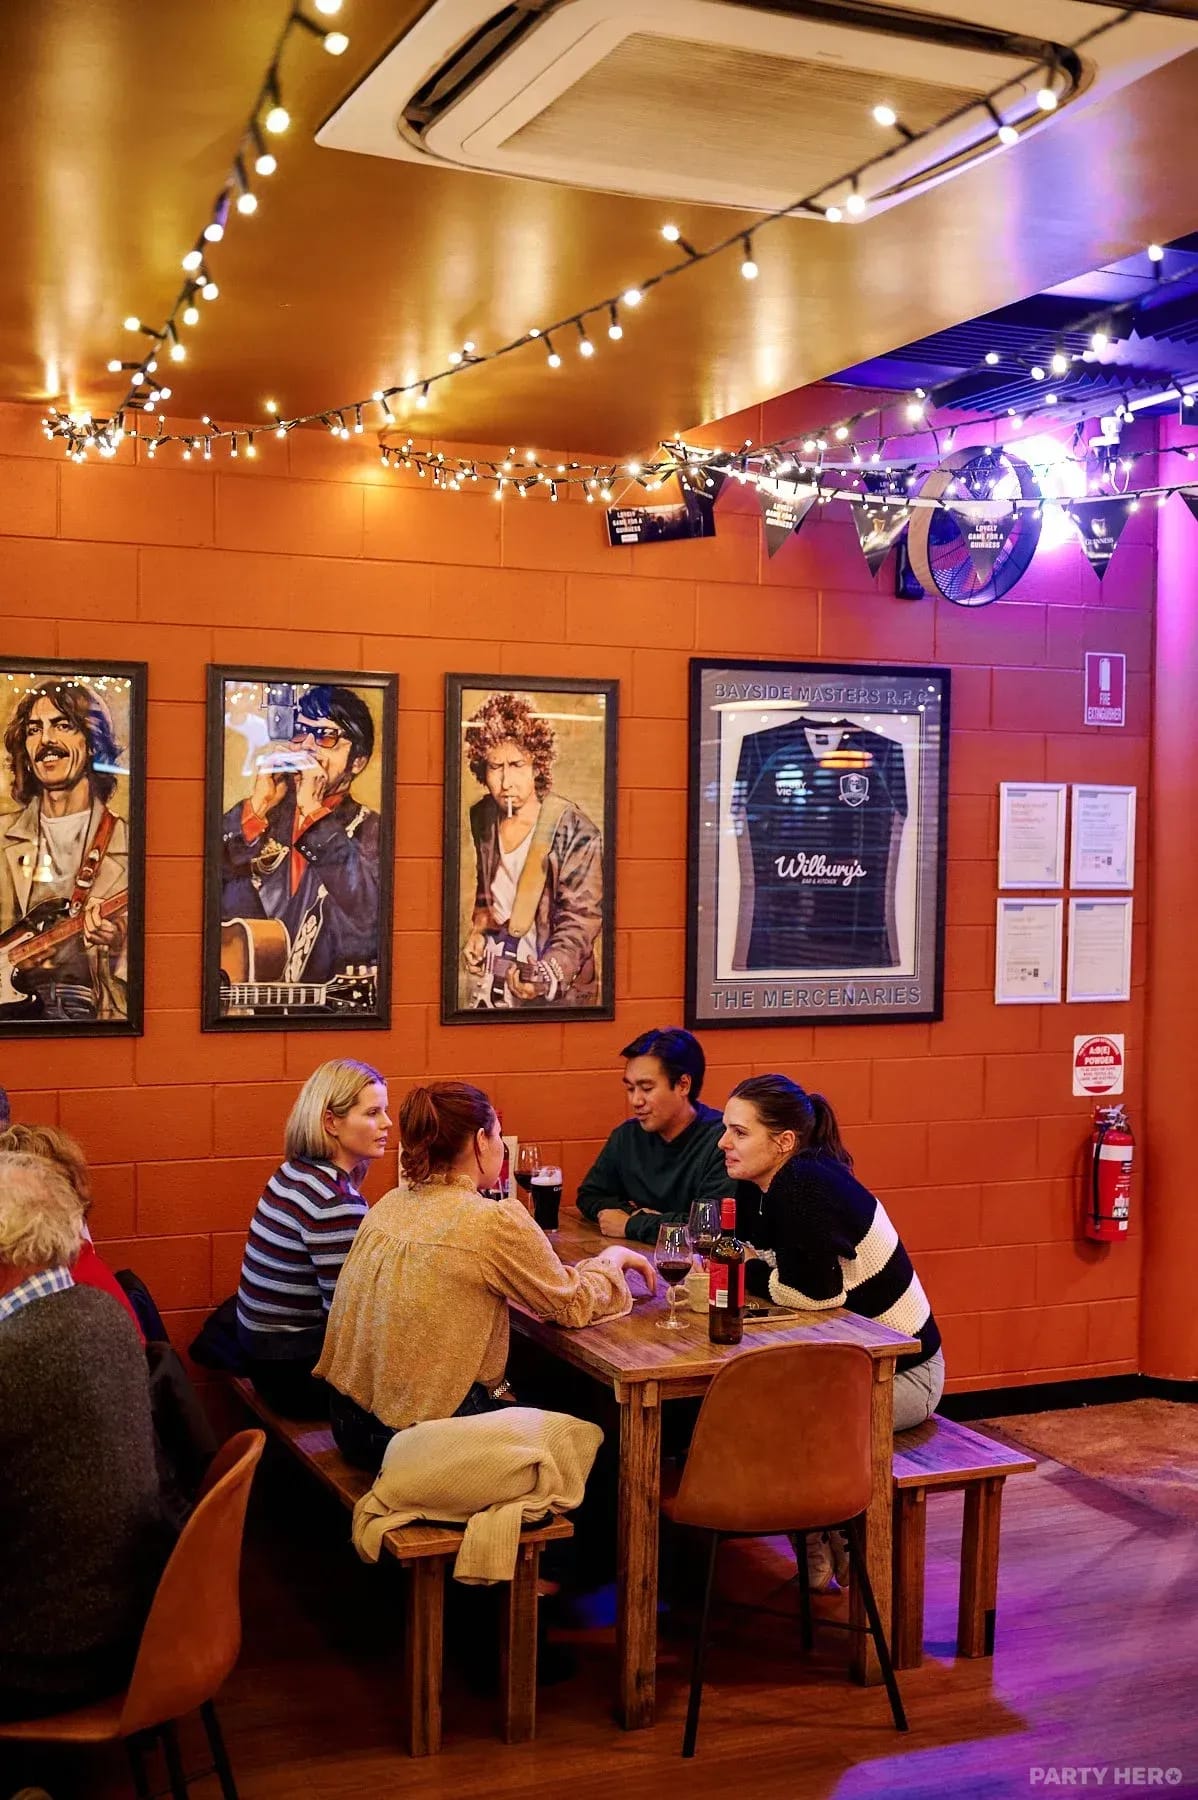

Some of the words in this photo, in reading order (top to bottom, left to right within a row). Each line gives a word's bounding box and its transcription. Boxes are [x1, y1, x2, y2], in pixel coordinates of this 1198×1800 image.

[975, 524, 998, 532] LOVELY
[968, 532, 985, 540] GAME
[986, 532, 999, 540] FOR
[970, 541, 1000, 549] GUINNESS
[715, 683, 793, 700] BAYSIDE
[798, 686, 881, 705] MASTERS
[775, 852, 867, 886] Wilbury's
[711, 990, 755, 1010] THE
[762, 986, 921, 1009] MERCENARIES
[1084, 1056, 1115, 1065] POWDER
